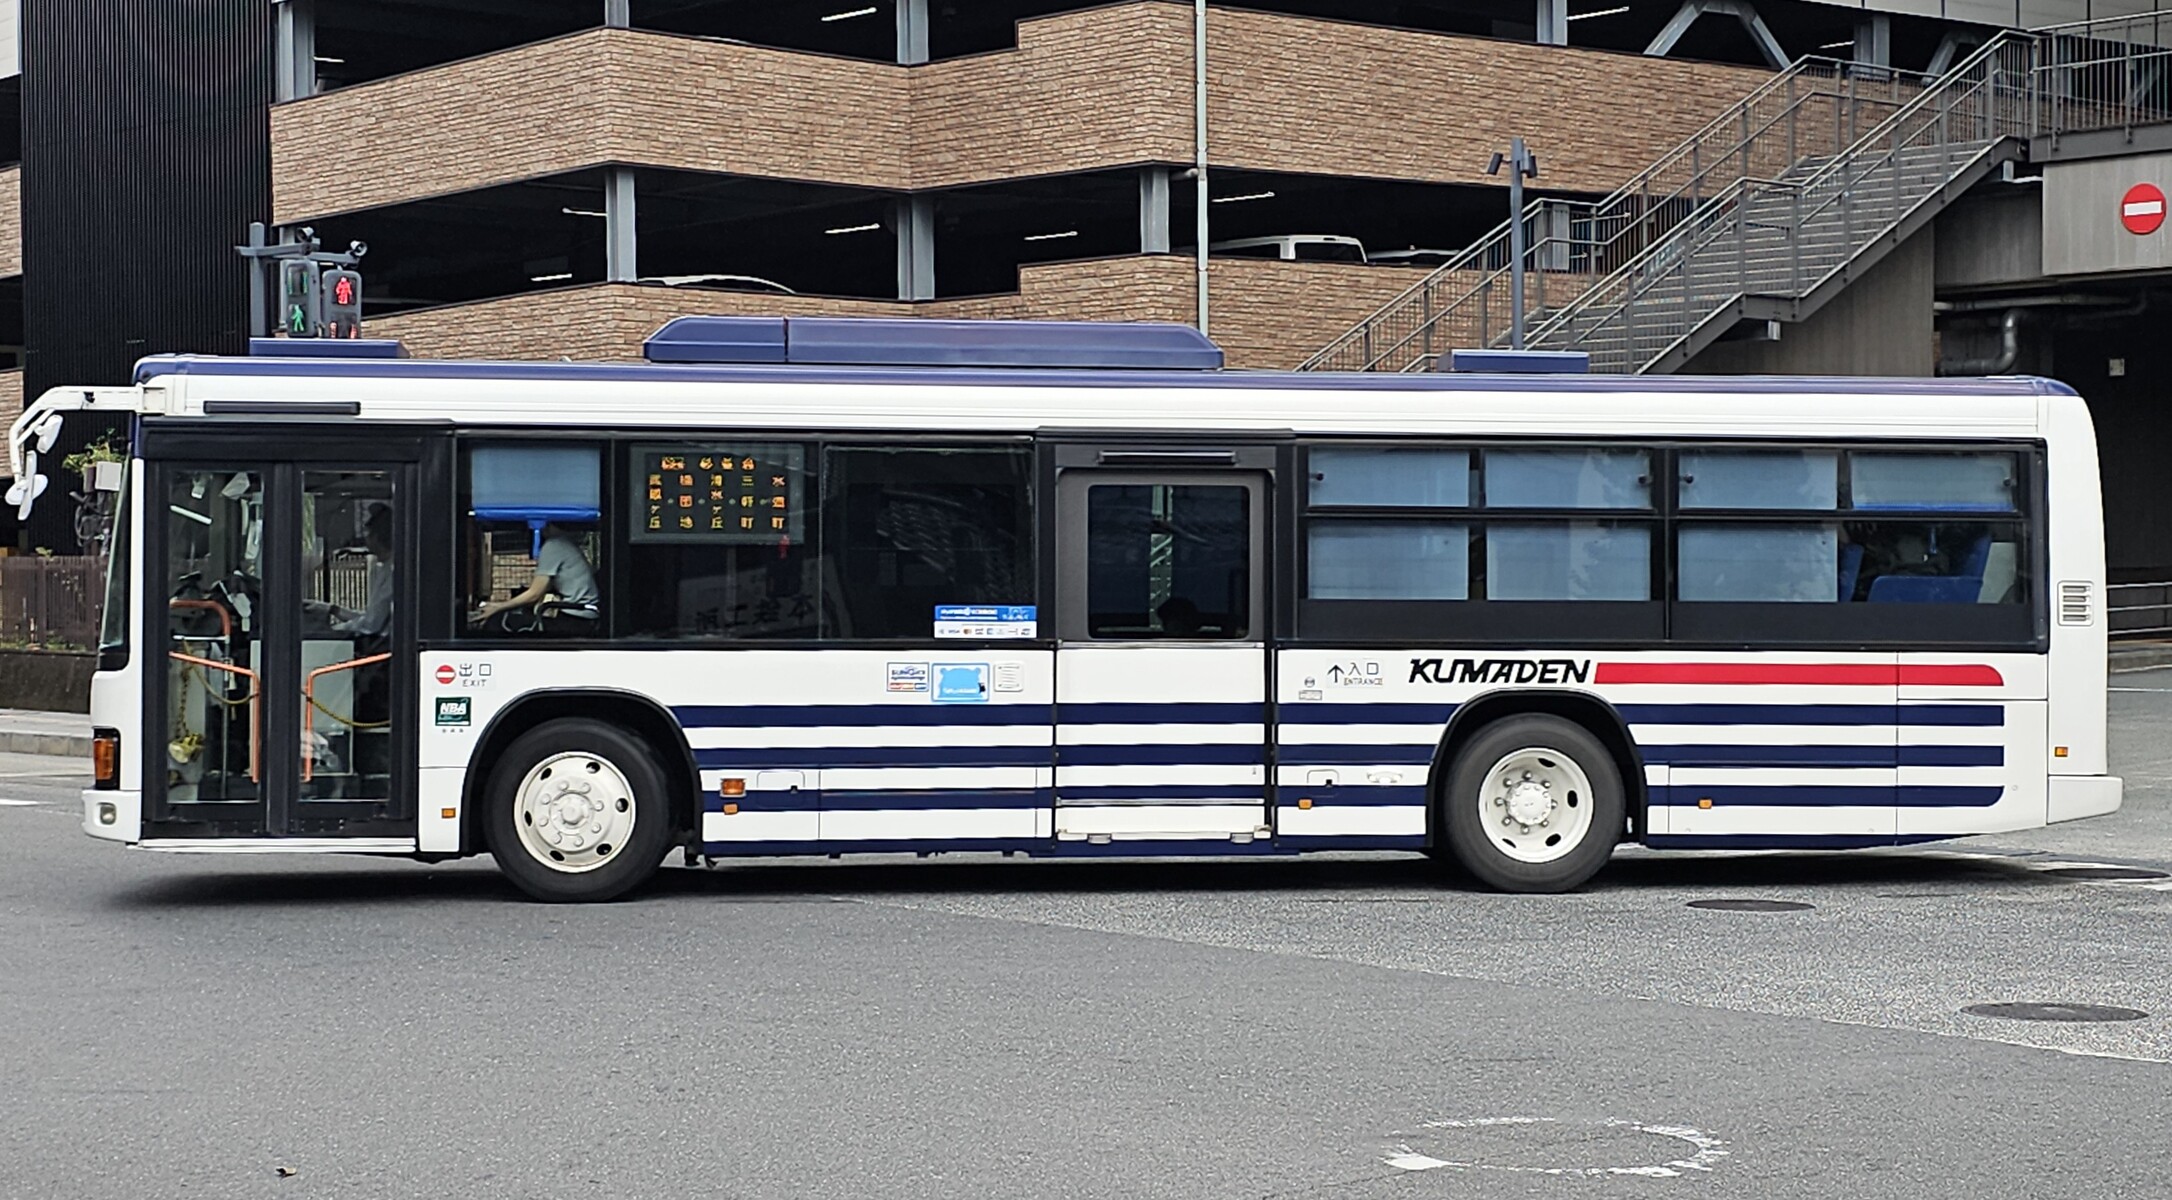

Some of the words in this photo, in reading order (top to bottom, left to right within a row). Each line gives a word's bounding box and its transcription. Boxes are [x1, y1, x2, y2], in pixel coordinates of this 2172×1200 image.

[459, 663, 492, 677] 出口
[1347, 662, 1380, 676] 入口
[1408, 658, 1591, 684] KUMADEN
[462, 679, 487, 687] EXIT
[1343, 677, 1384, 686] ENTRANCE
[440, 702, 467, 715] NBA
